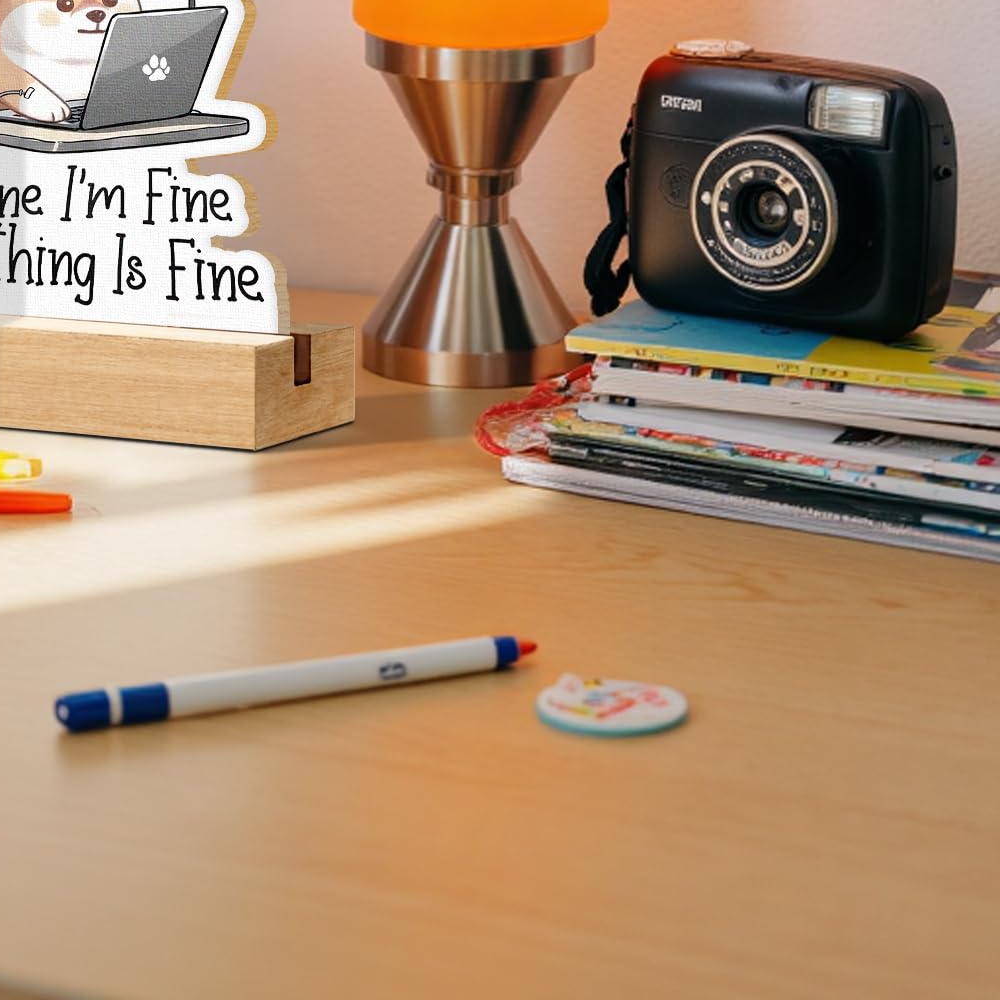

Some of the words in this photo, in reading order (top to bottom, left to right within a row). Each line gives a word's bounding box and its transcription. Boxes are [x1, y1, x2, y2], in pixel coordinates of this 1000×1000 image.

[59, 165, 127, 222] I'm
[142, 166, 233, 226] Fine
[112, 232, 147, 296] Is
[165, 237, 265, 303] Fine
